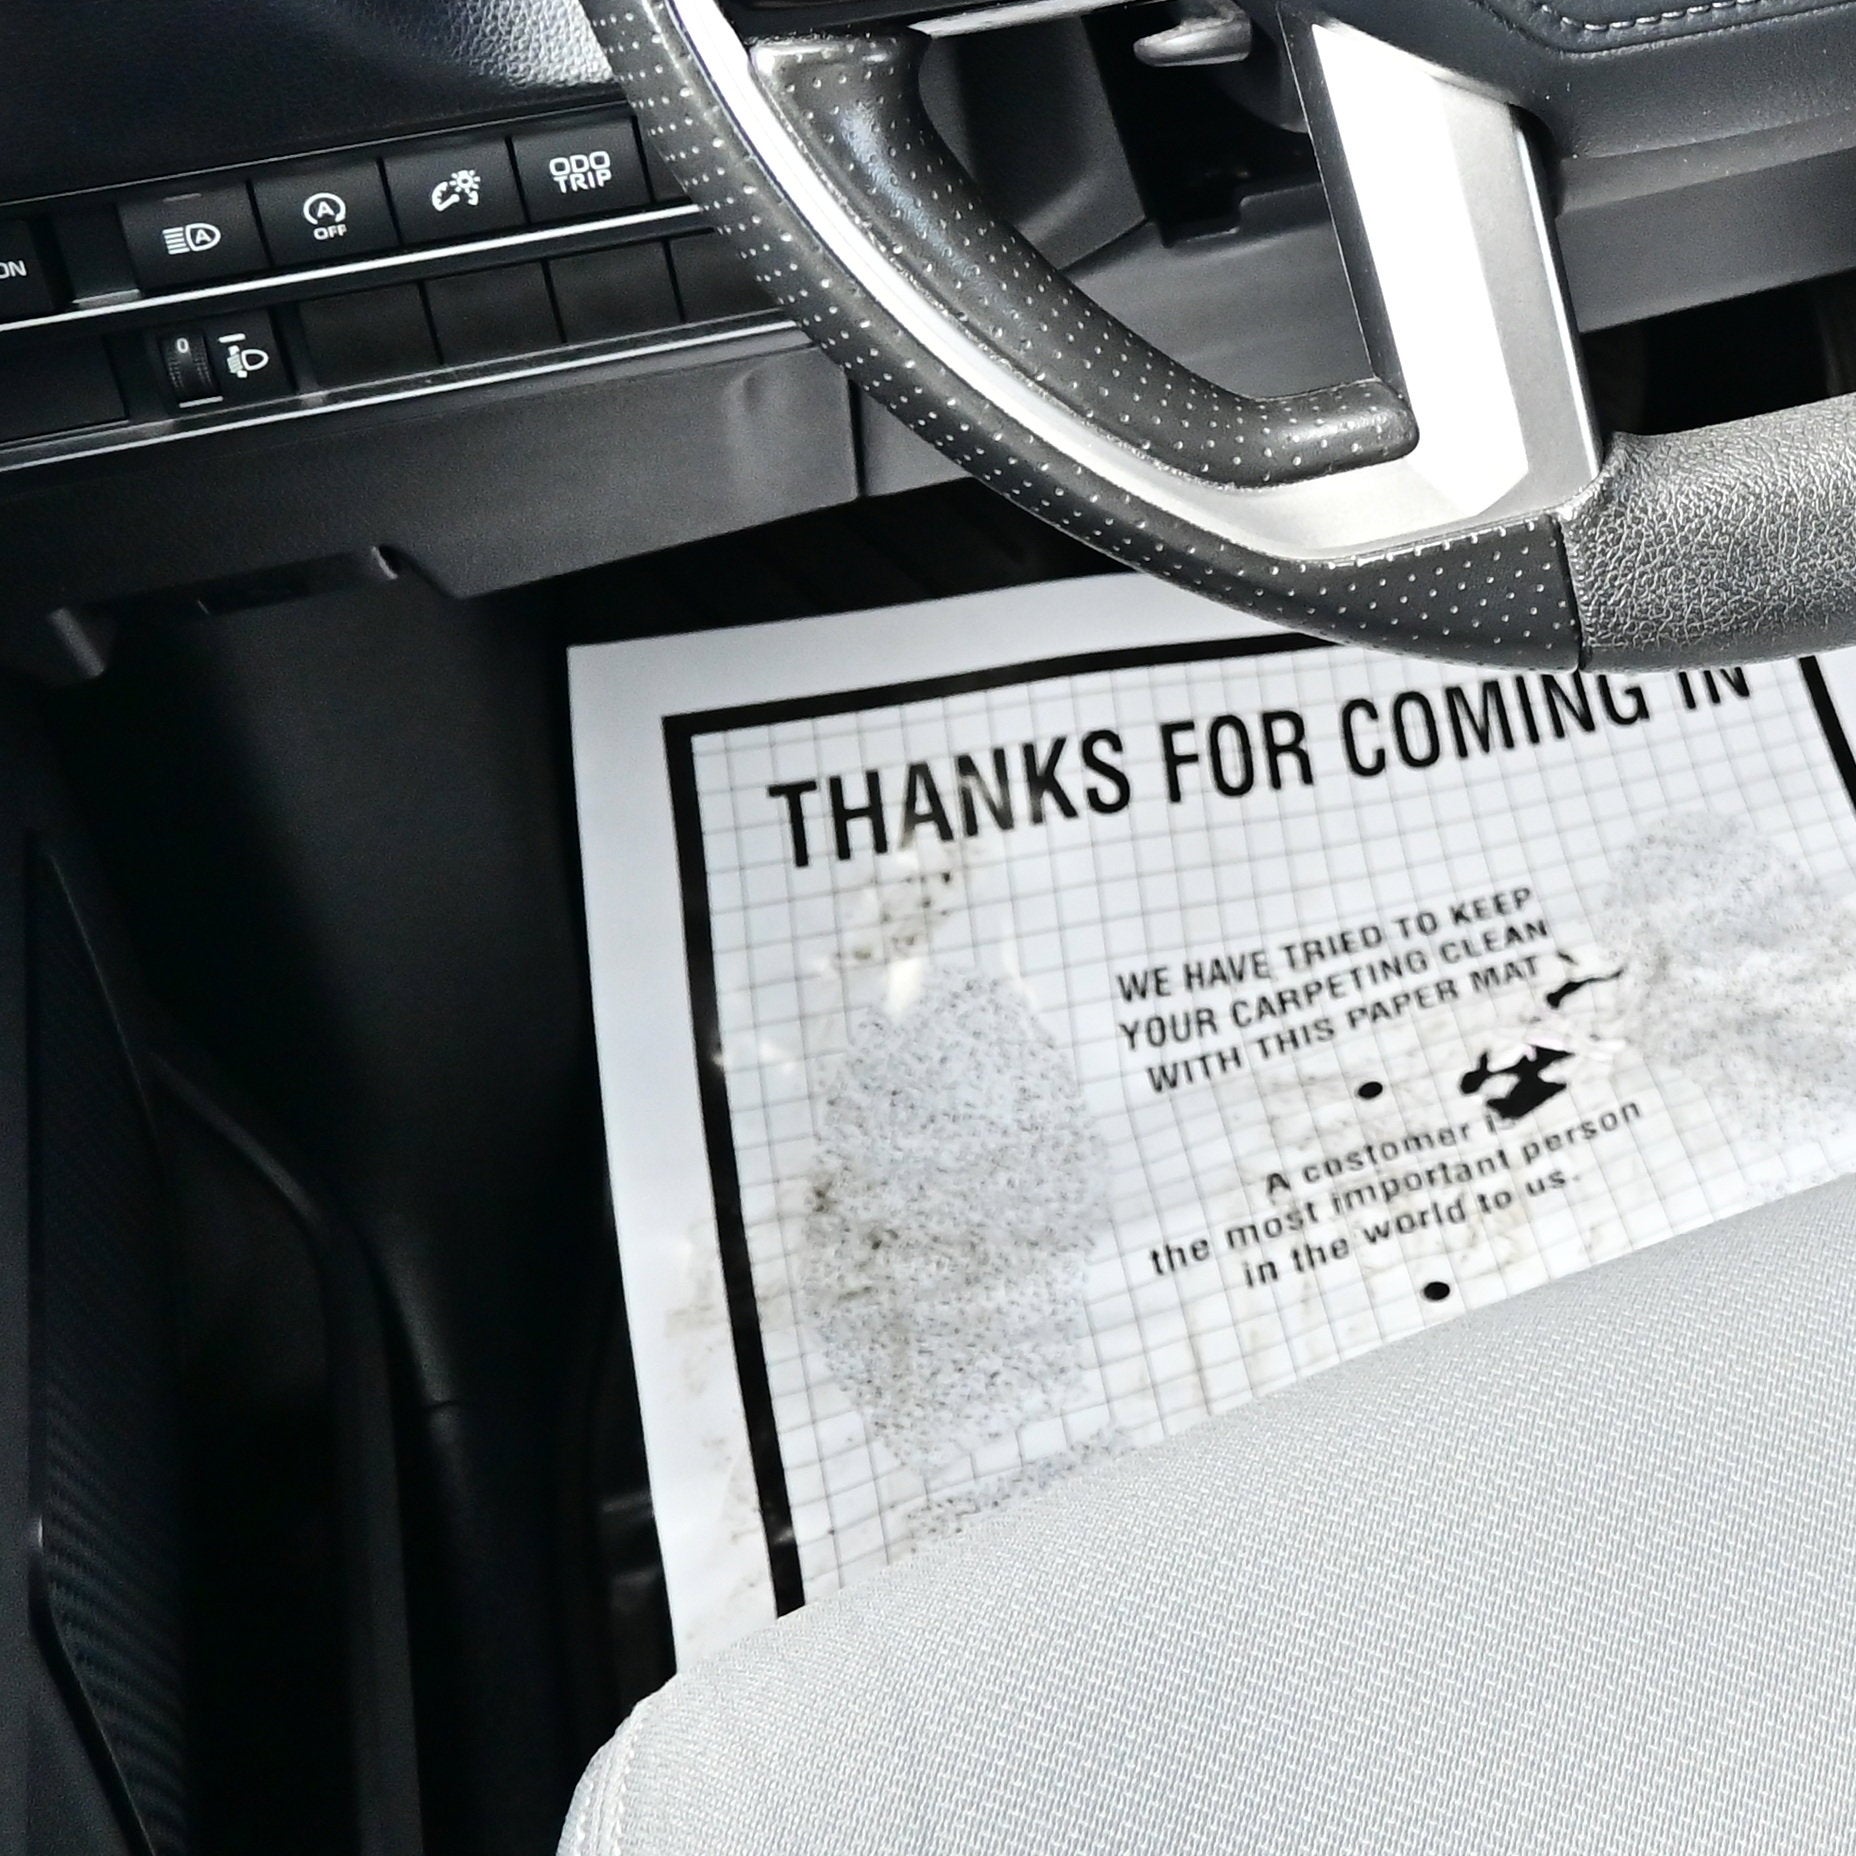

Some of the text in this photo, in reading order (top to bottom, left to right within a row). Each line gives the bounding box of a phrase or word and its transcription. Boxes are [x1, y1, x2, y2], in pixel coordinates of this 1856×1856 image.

[549, 150, 611, 176] ODO
[553, 169, 612, 194] TRIP
[313, 223, 347, 241] OFF
[177, 338, 189, 354] 0
[767, 729, 1131, 868] THANKS
[1160, 710, 1314, 804] FOR
[1340, 669, 1651, 780] COMING
[1117, 887, 1531, 1004] WE HAVE TRIED TO KEEP
[1118, 919, 1548, 1051] YOUR CARPETING CLEAN
[1147, 955, 1538, 1093] WITH THIS PAPER MAT
[1150, 1100, 1643, 1276] the most important person
[1266, 1171, 1292, 1196] A
[1302, 1121, 1471, 1184] customer
[1243, 1169, 1581, 1289] in the world to us.
